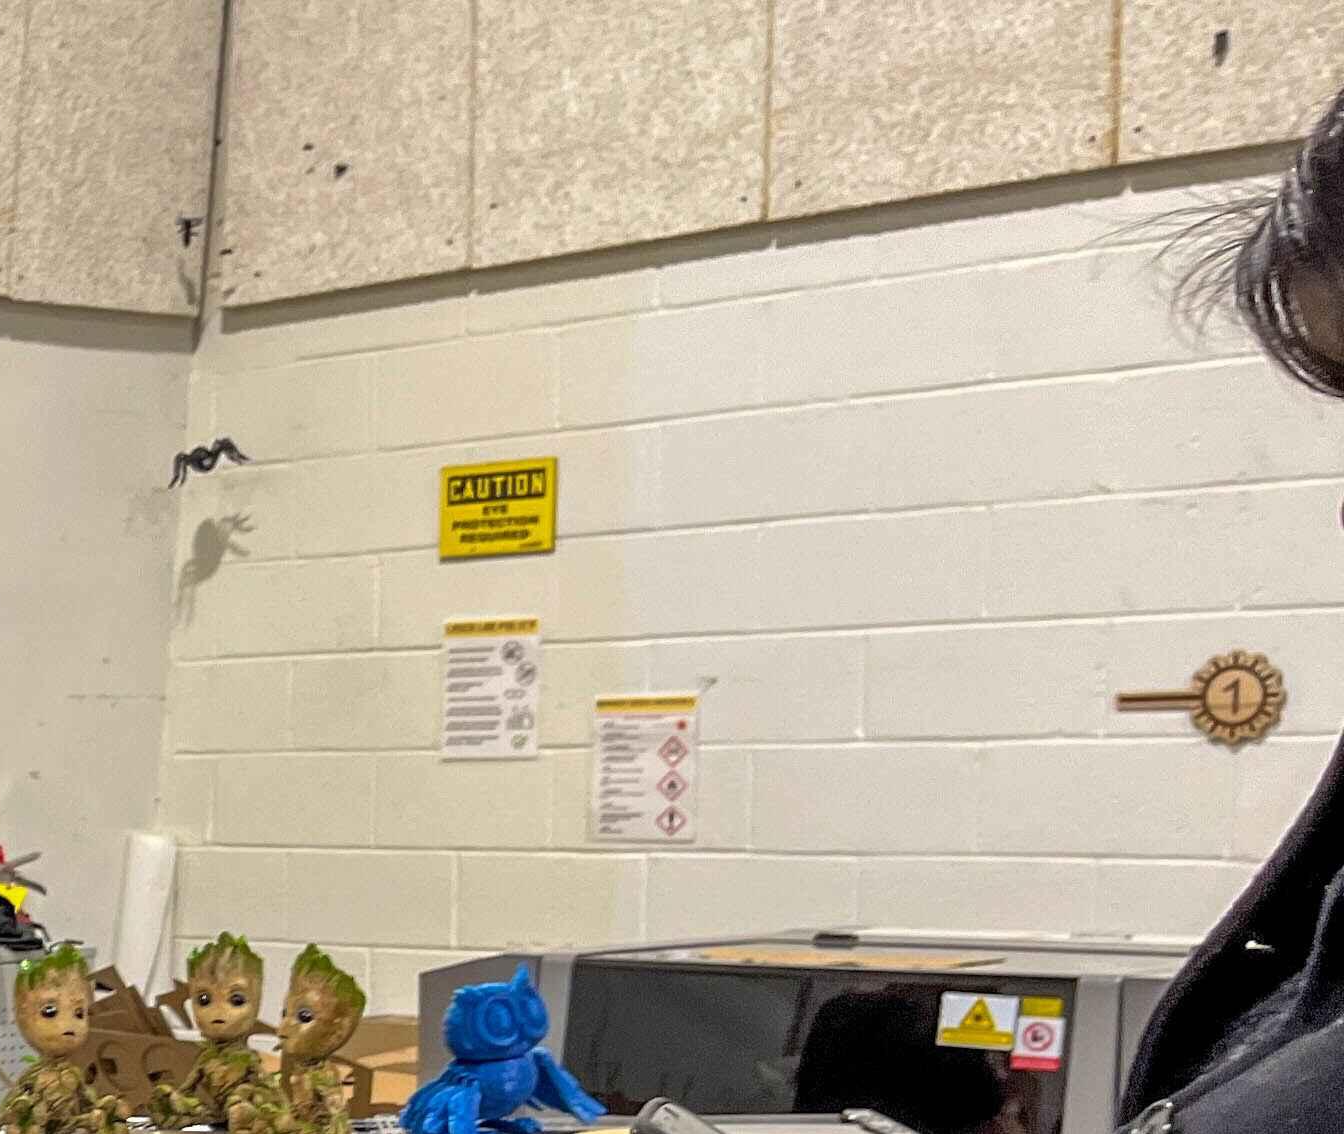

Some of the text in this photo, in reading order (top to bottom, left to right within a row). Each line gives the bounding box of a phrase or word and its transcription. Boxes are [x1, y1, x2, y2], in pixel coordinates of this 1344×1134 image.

[449, 472, 545, 501] CAUTION
[482, 504, 509, 516] EYE
[451, 515, 540, 531] PROTECTION
[459, 529, 530, 544] REQUIRED
[1223, 677, 1242, 715] 1
